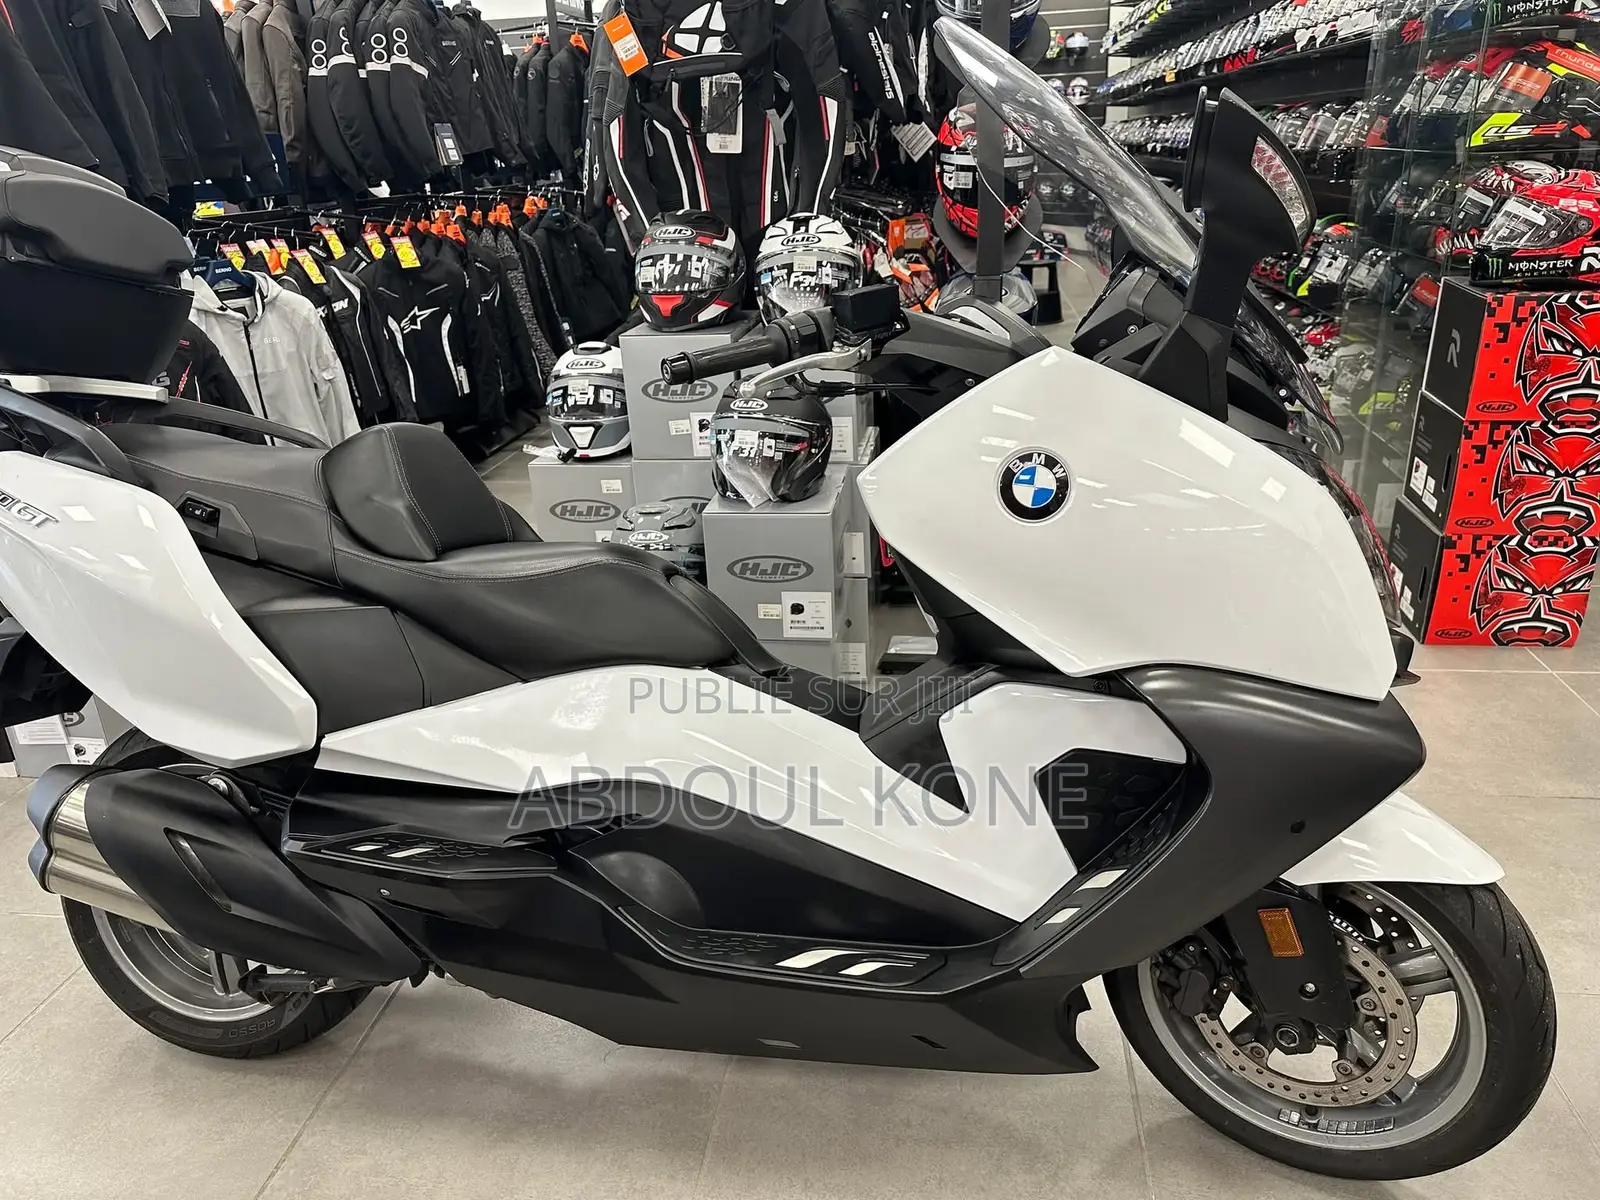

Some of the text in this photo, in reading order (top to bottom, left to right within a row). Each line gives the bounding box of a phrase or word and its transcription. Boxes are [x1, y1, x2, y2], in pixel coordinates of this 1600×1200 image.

[1508, 259, 1574, 271] MONSTER
[1480, 402, 1515, 412] HJC
[1008, 453, 1067, 479] BMW
[1460, 518, 1493, 527] HJC
[737, 562, 805, 576] HJC
[1441, 628, 1471, 638] HJC
